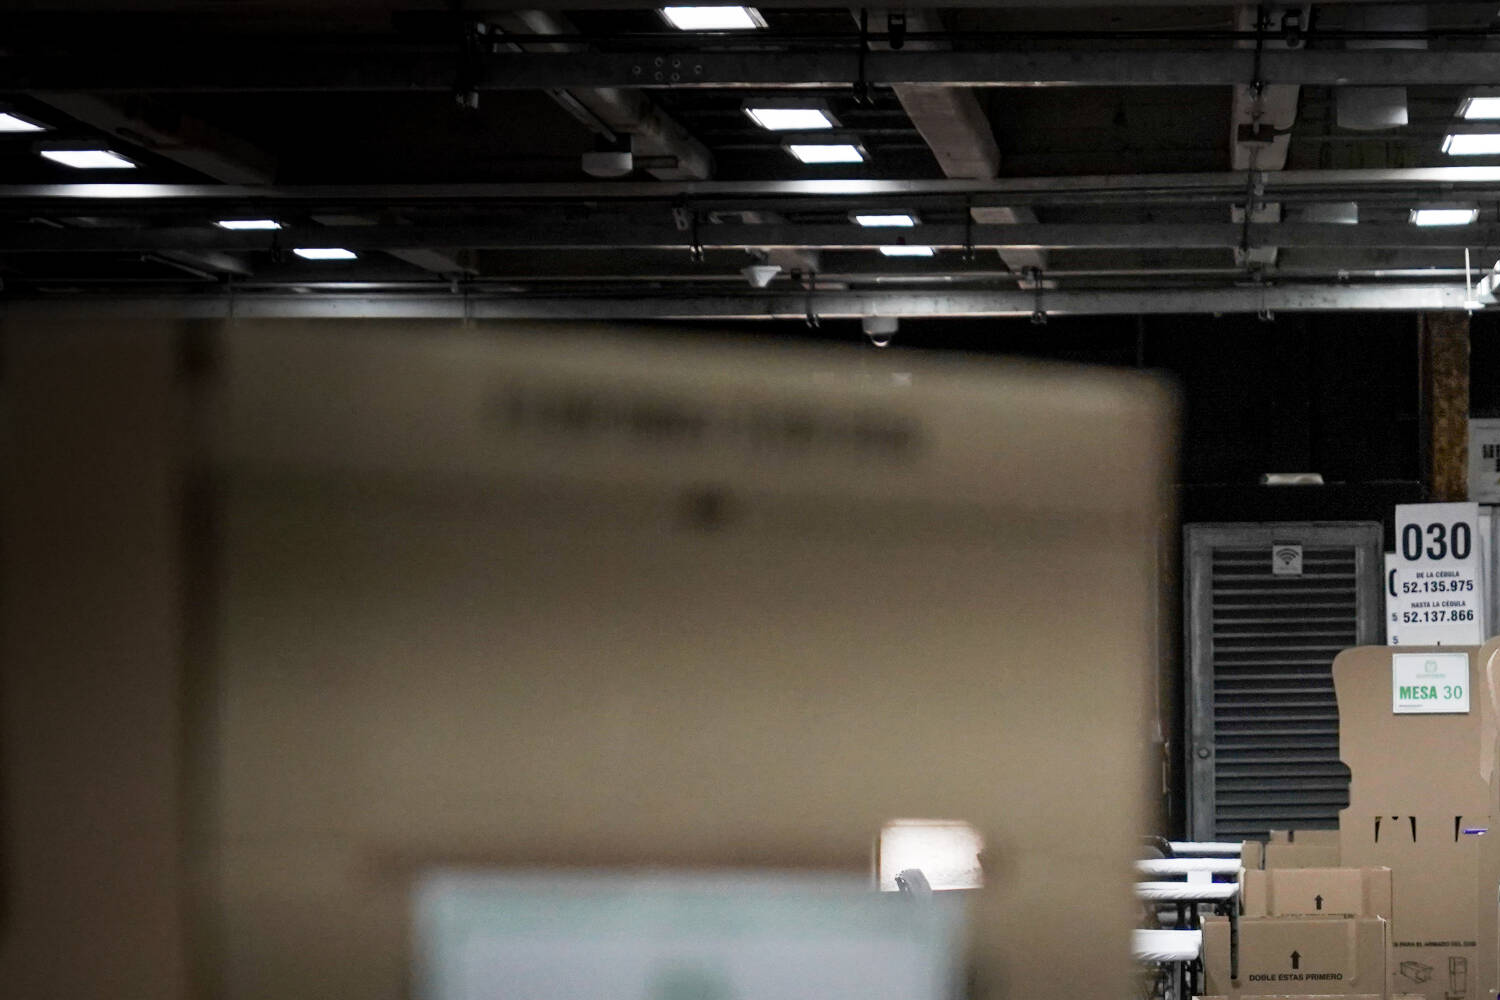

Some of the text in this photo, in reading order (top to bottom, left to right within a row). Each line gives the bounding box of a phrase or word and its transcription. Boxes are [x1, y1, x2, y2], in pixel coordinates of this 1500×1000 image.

[1402, 521, 1472, 562] 030
[1402, 579, 1474, 594] 52.135.975
[1402, 608, 1475, 625] 52.137.866
[1399, 685, 1463, 700] MESA 30
[1248, 973, 1343, 982] DOBLE ESTAS PRIMERO
